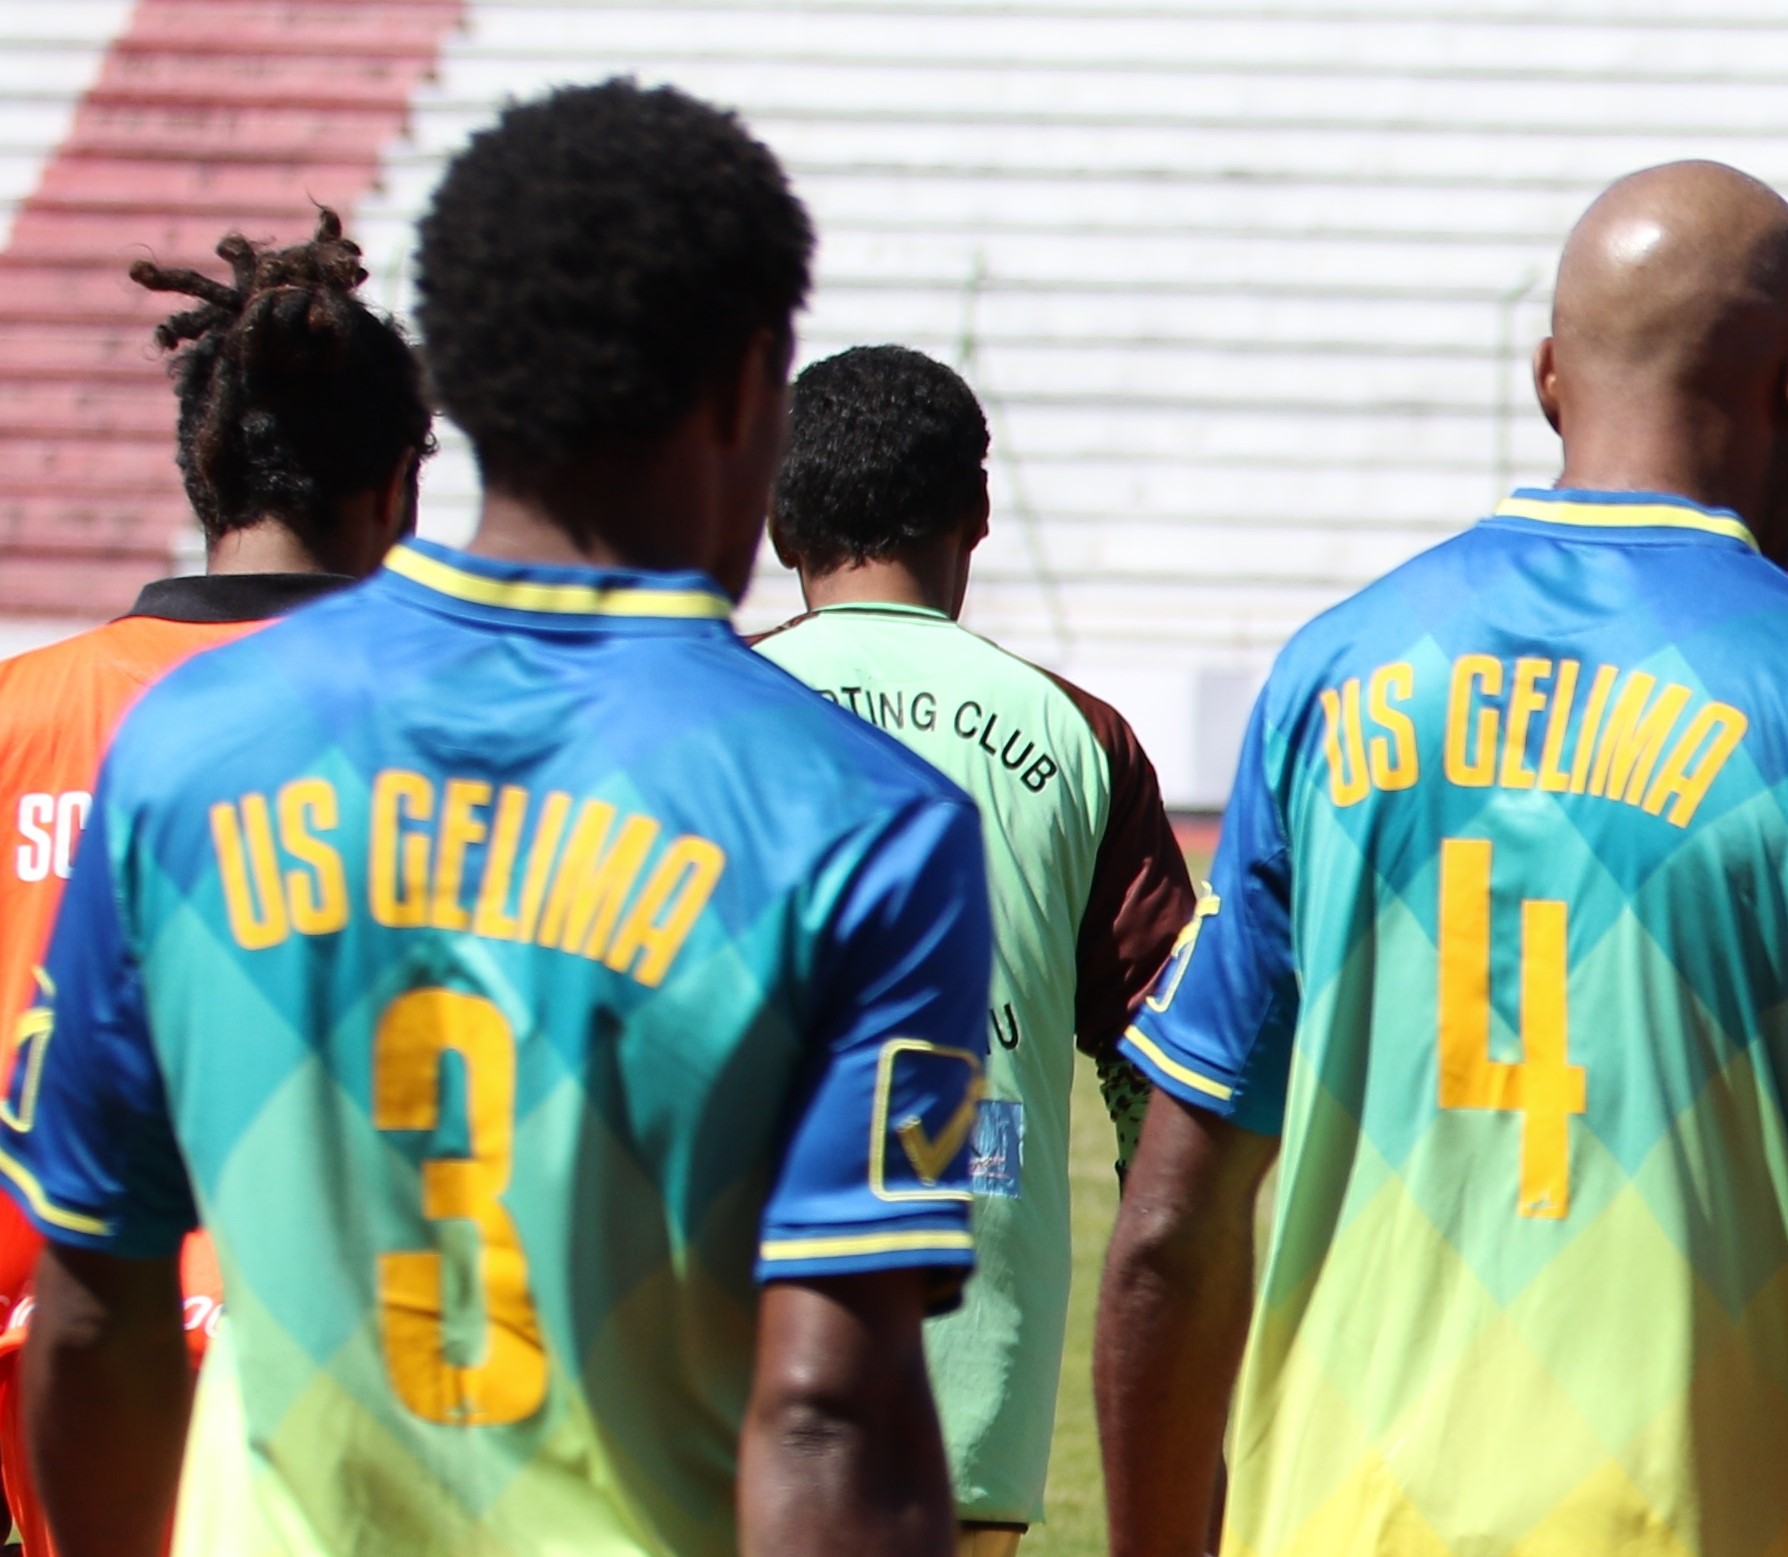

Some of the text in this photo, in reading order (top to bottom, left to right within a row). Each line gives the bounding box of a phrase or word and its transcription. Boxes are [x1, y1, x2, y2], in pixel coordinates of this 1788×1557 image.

[14, 788, 94, 884] SC
[953, 701, 1058, 793] CLUB
[1321, 654, 1749, 829] US GELIMA
[211, 769, 725, 988] US GELIMA
[1438, 838, 1587, 1220] 4
[372, 986, 550, 1427] 3
